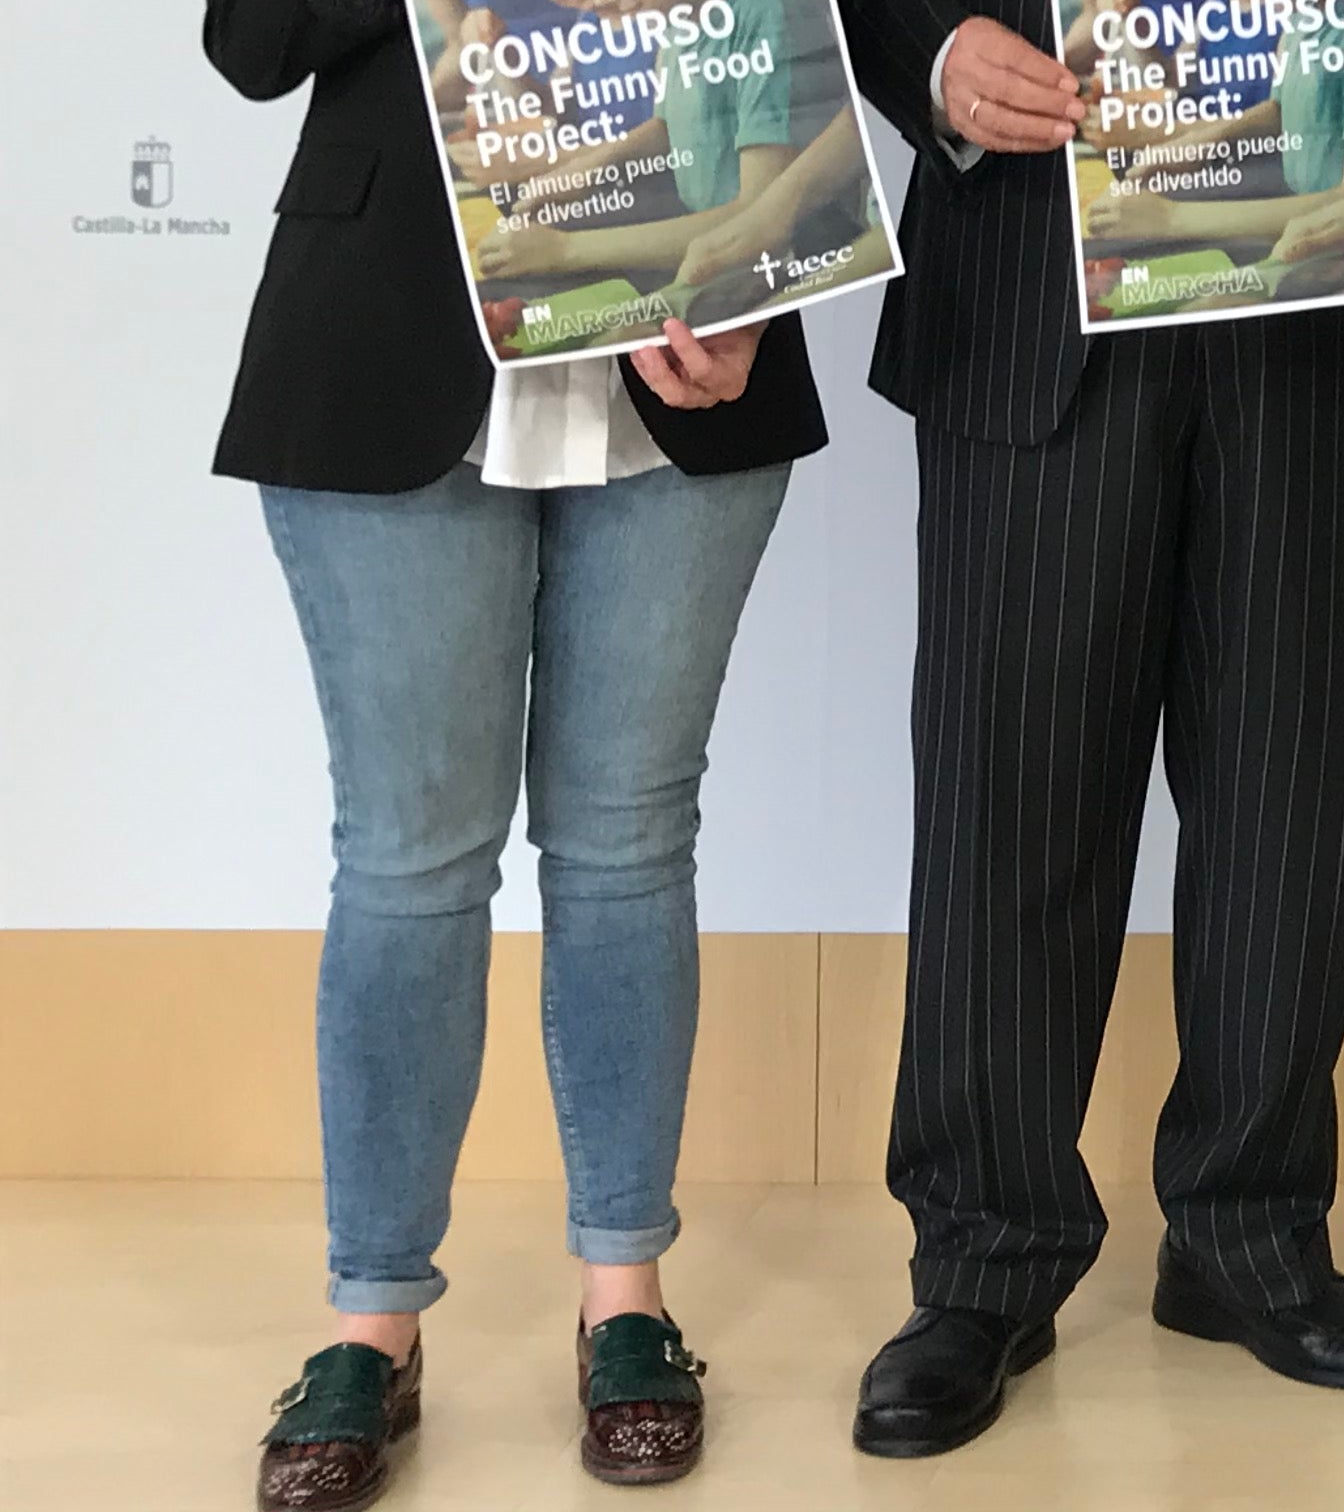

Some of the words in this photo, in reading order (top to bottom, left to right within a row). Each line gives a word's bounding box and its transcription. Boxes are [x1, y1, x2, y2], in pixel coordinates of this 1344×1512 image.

[466, 90, 542, 130] The
[552, 67, 668, 114] Funny
[679, 46, 774, 88] Food
[1095, 58, 1165, 94] The
[1177, 48, 1288, 93] Funny
[1101, 89, 1243, 135] Project:
[476, 114, 628, 167] Project:
[1107, 148, 1127, 169] El
[1133, 143, 1230, 167] almuerzo
[1237, 132, 1303, 161] puede
[490, 181, 513, 206] El
[516, 163, 620, 202] almuerzo
[626, 148, 694, 184] puede
[1109, 178, 1143, 198] ser
[1148, 166, 1242, 192] divertido
[167, 217, 231, 236] Mancha
[496, 211, 536, 234] ser
[539, 188, 634, 223] divertido
[787, 245, 854, 278] aecc
[1121, 266, 1149, 285] EN
[1121, 266, 1263, 306] MARCHA
[522, 303, 552, 323] EN
[525, 293, 673, 343] MARCHA
